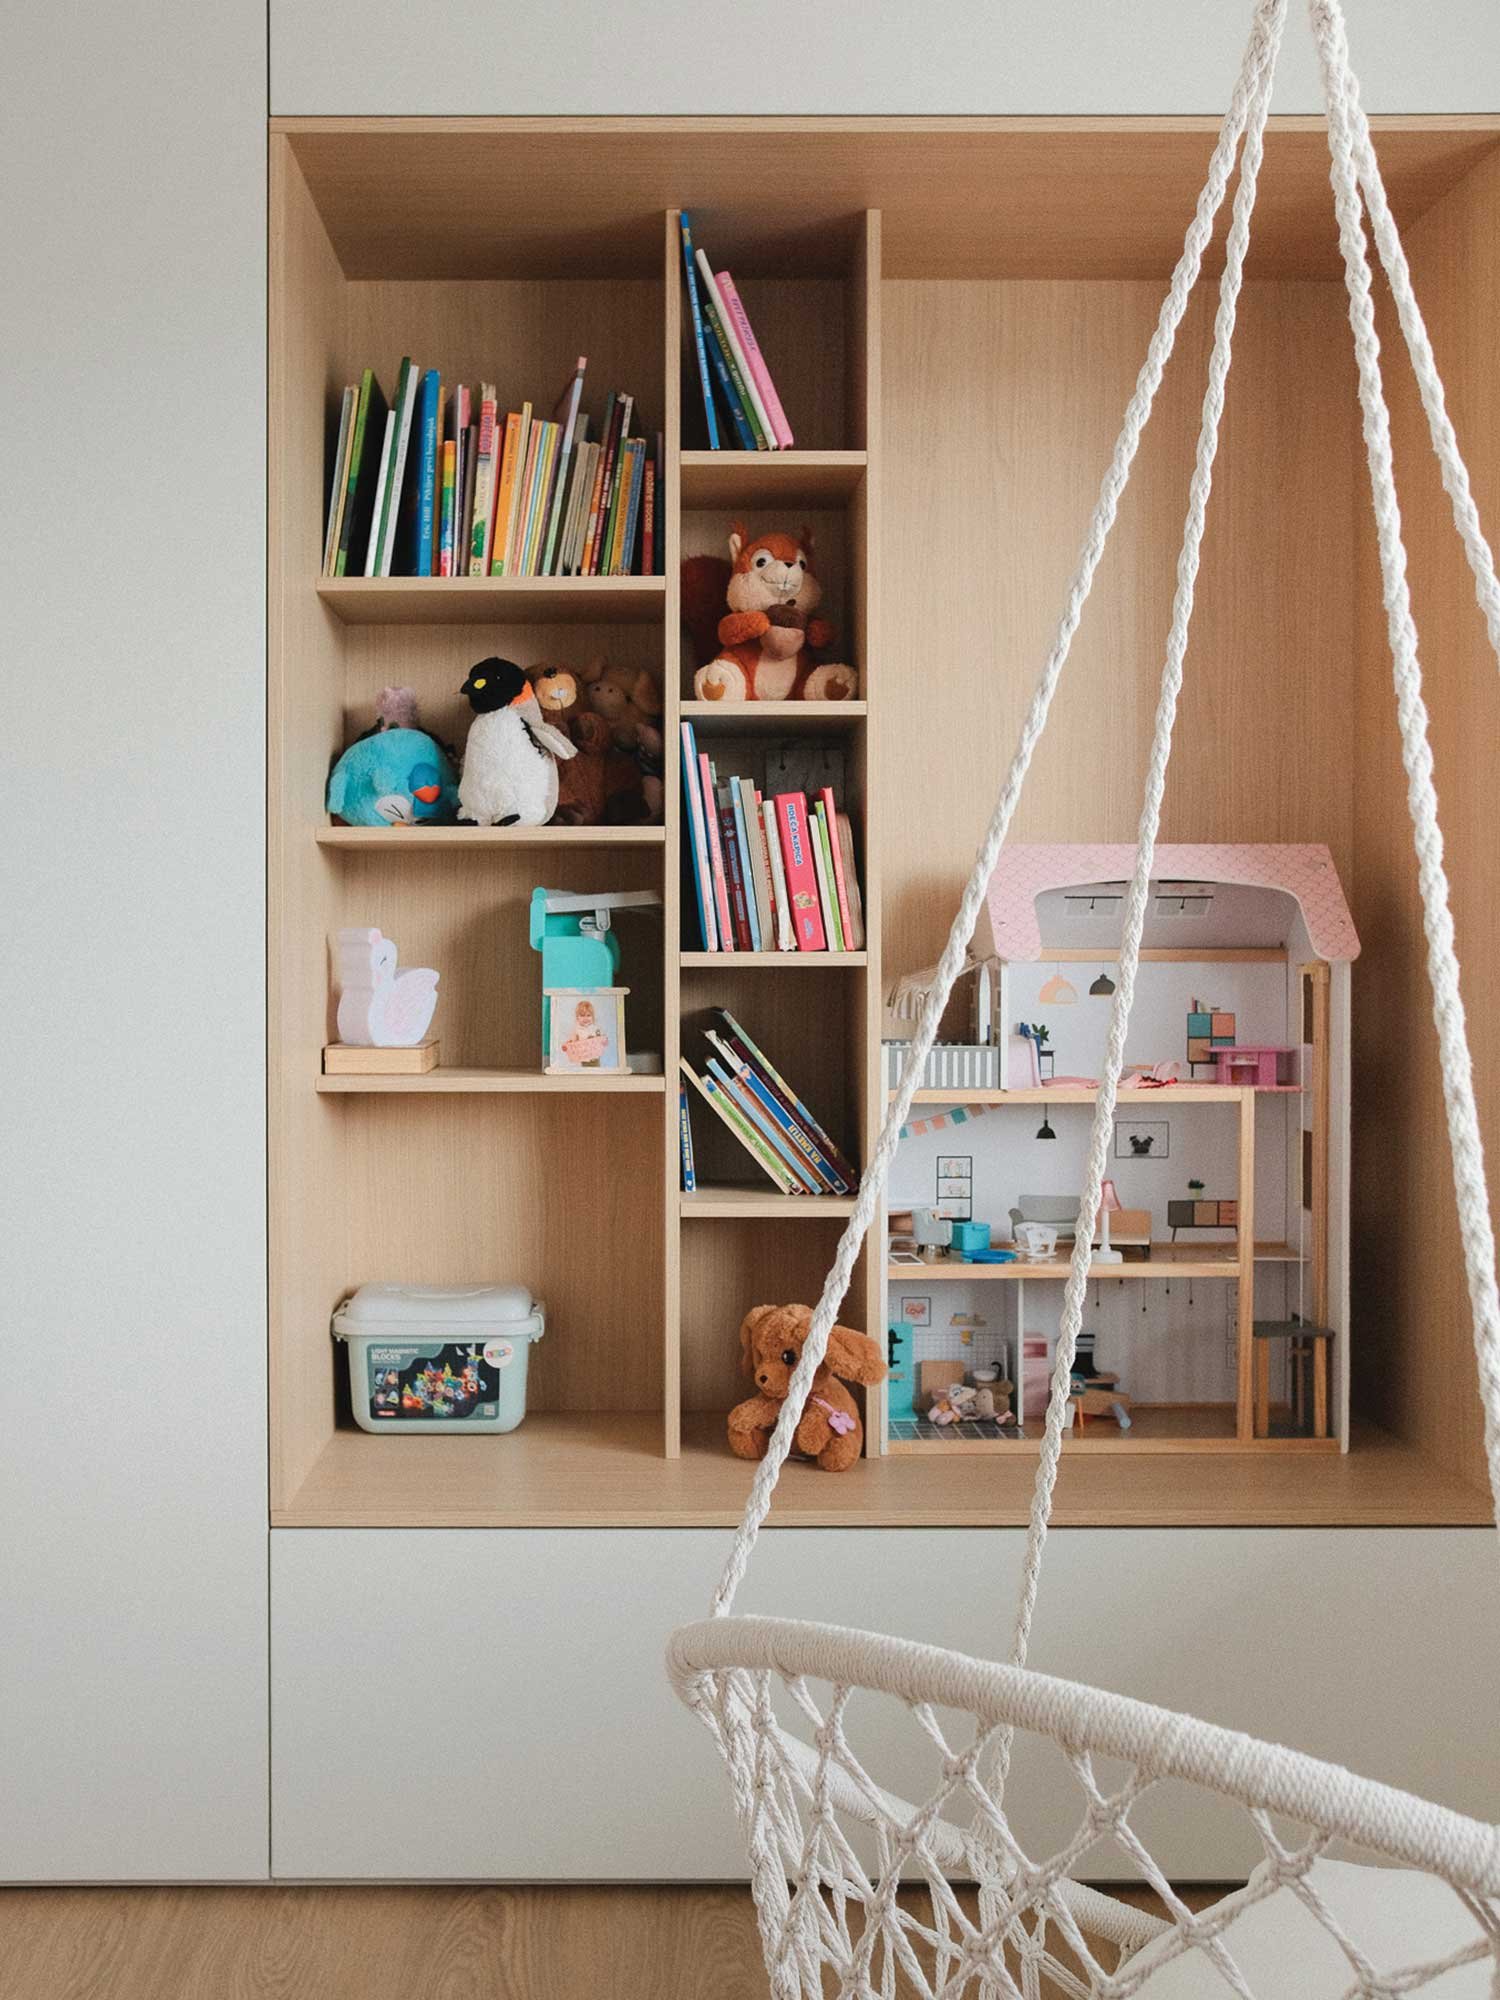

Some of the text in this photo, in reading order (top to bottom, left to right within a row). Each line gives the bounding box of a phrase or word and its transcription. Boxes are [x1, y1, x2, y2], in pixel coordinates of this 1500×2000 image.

[423, 506, 432, 522] Hill
[787, 803, 803, 867] RDEČA KAPICA
[371, 1353, 401, 1361] BLOCKS
